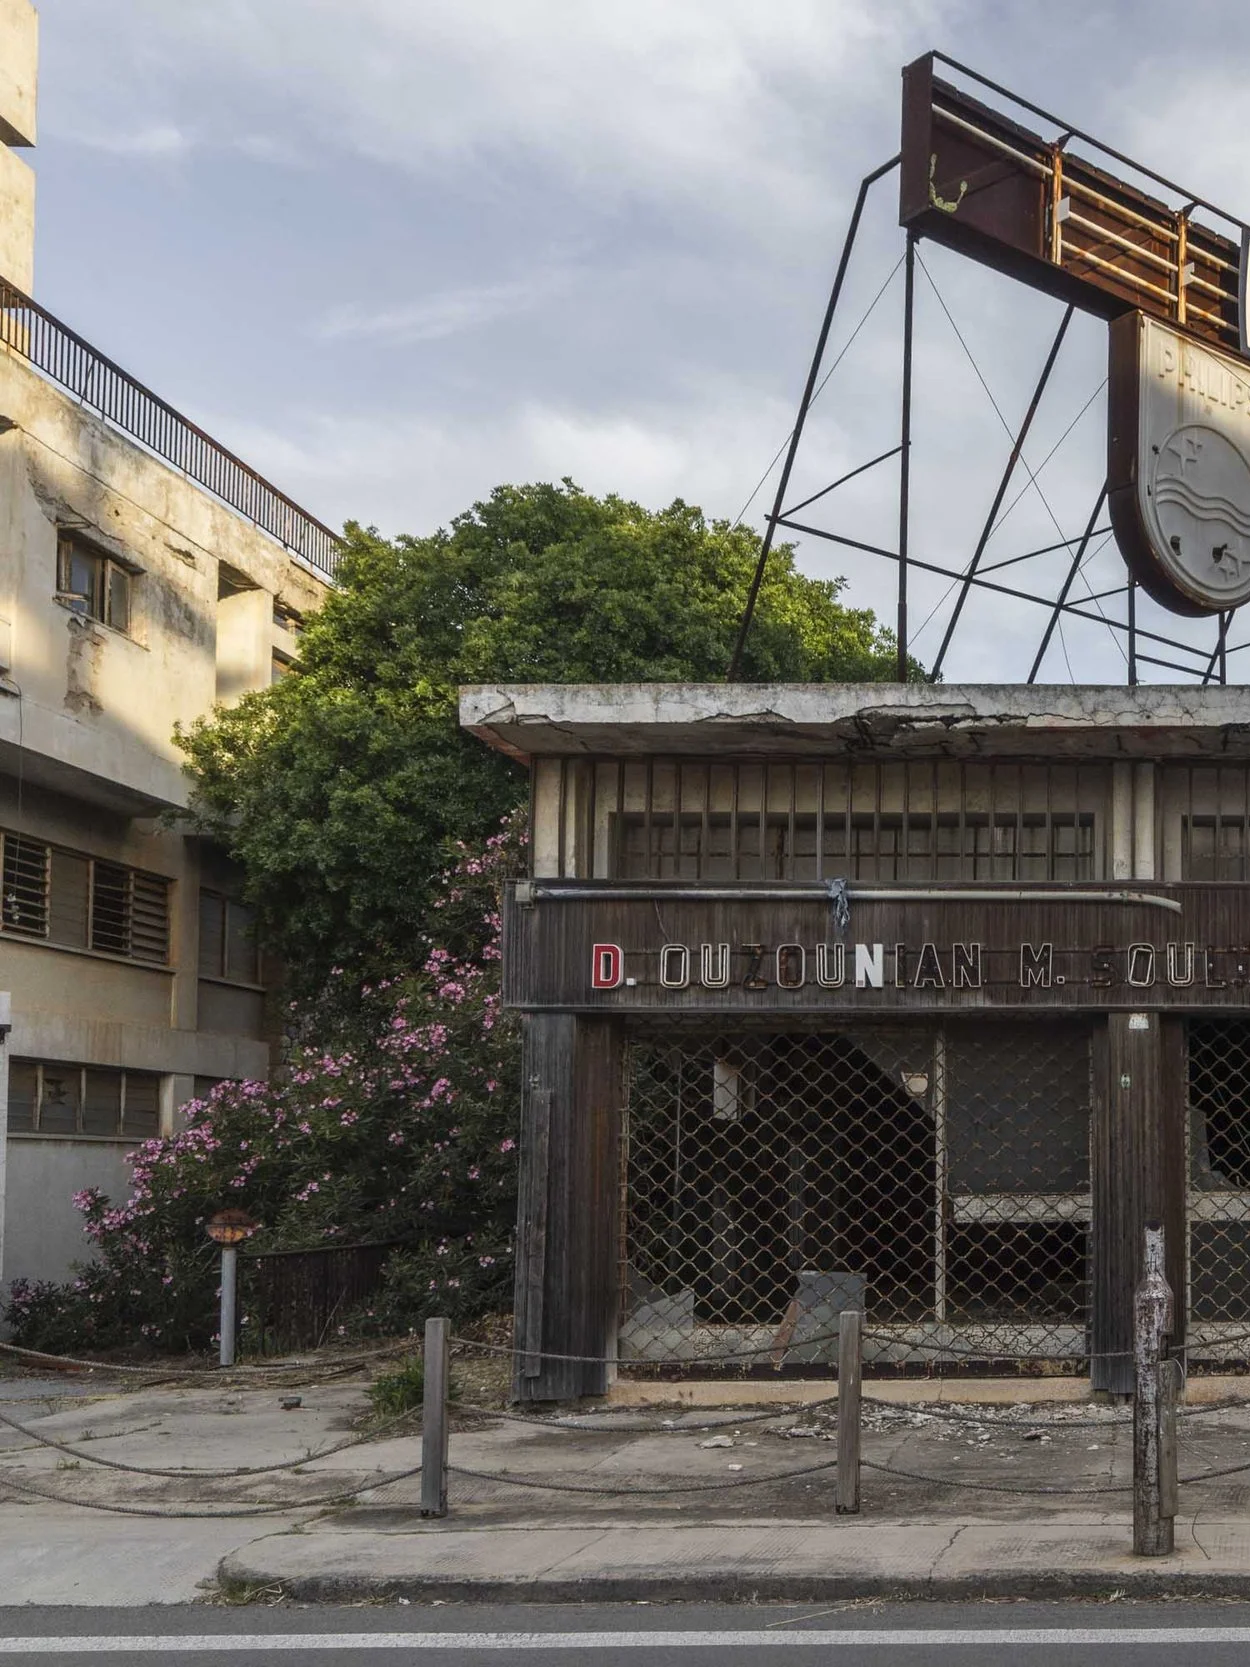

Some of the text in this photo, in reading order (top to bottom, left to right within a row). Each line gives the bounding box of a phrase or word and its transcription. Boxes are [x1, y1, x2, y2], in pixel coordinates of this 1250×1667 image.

[591, 943, 636, 989] D.
[660, 943, 981, 990] OUZOUNIAN
[1020, 942, 1066, 988] M.
